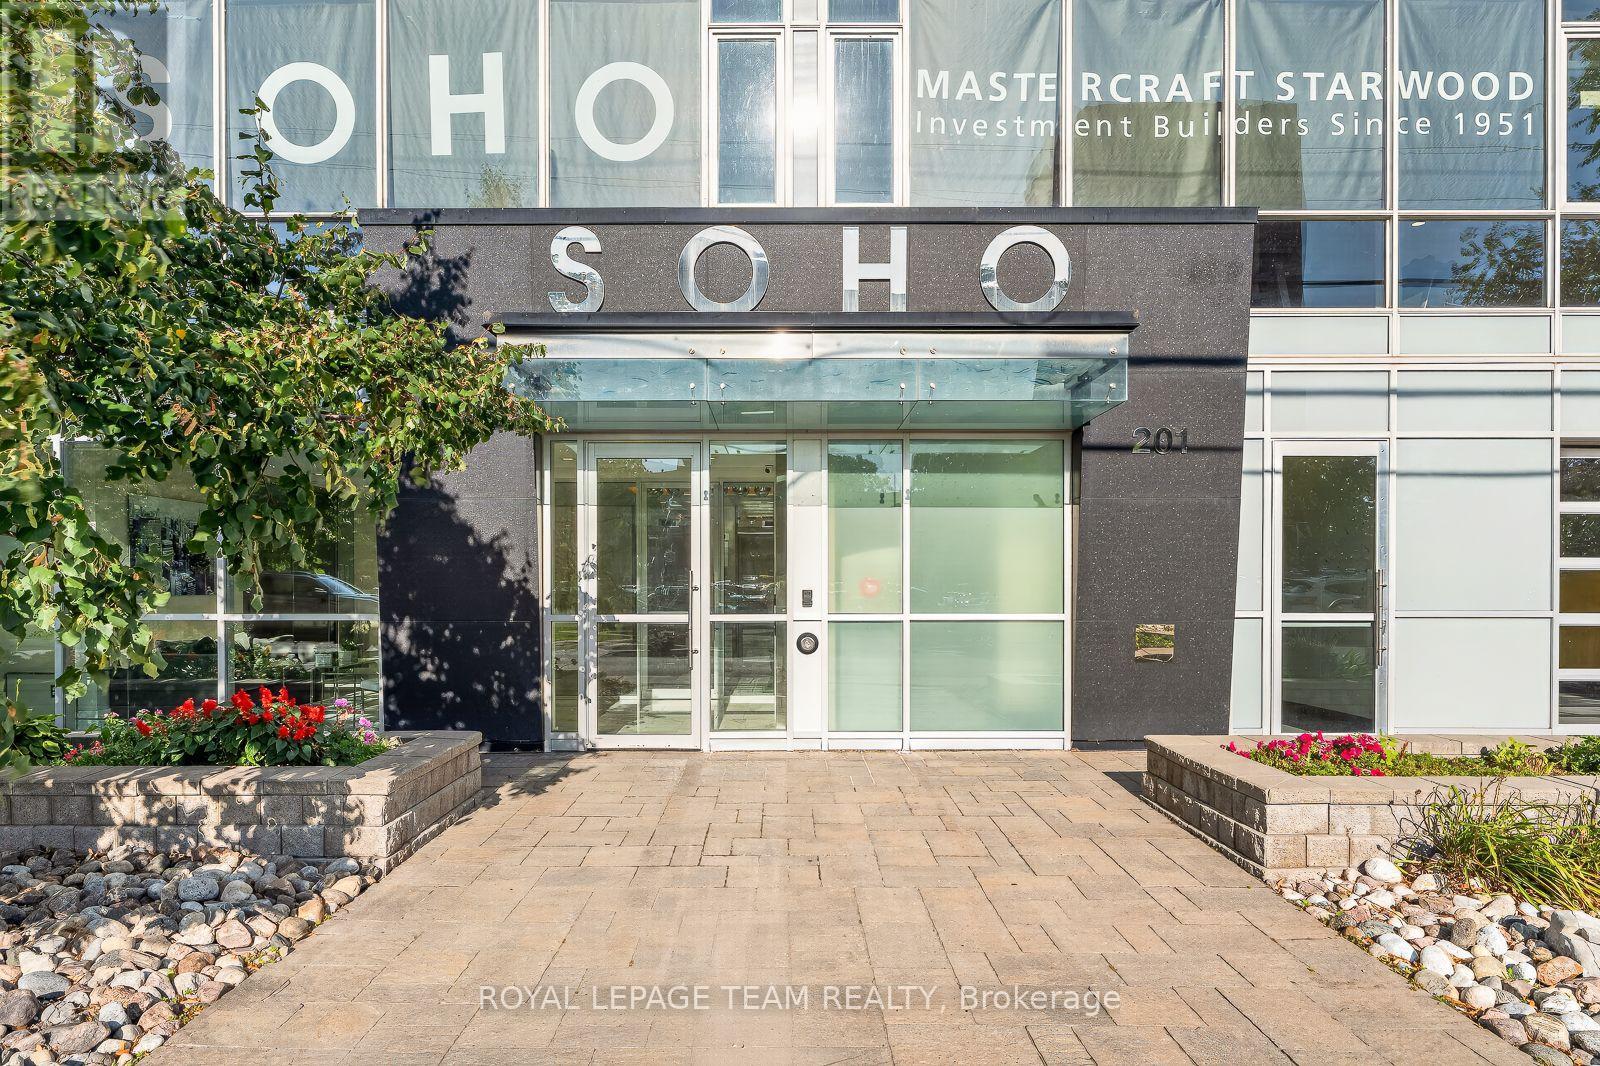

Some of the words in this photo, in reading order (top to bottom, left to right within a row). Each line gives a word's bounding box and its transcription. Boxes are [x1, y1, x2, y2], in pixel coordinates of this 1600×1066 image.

[1275, 71, 1534, 101] STARWOOD
[916, 110, 1132, 138] Investment
[1153, 112, 1309, 138] Builders
[1331, 111, 1431, 136] Since
[1454, 112, 1534, 136] 1951
[548, 225, 1071, 312] SOHO
[1132, 427, 1188, 455] 201
